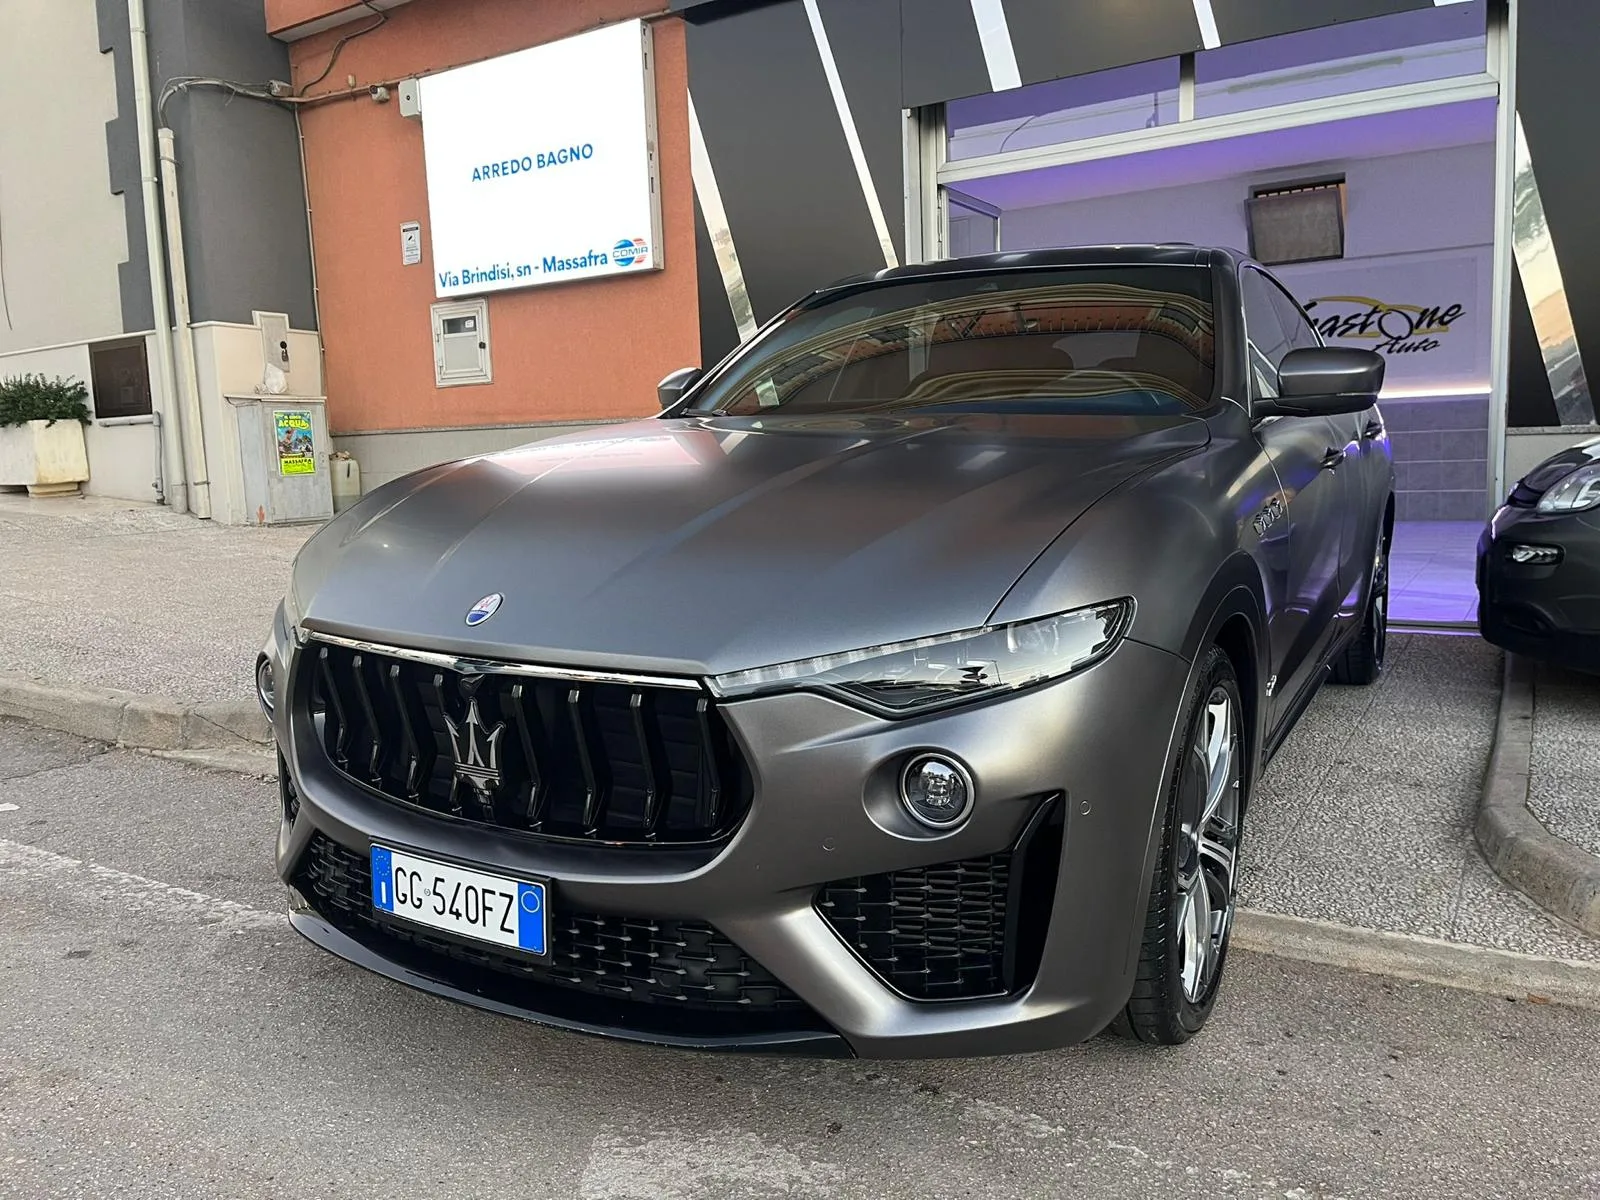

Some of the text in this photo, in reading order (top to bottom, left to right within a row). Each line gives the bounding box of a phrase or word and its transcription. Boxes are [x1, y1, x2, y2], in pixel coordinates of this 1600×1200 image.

[472, 143, 594, 182] ARREDO BAGNO
[439, 270, 459, 288] Via
[462, 262, 515, 285] Brindisi,
[517, 262, 531, 277] sn
[543, 249, 608, 274] Massafra
[1371, 335, 1441, 354] Auto
